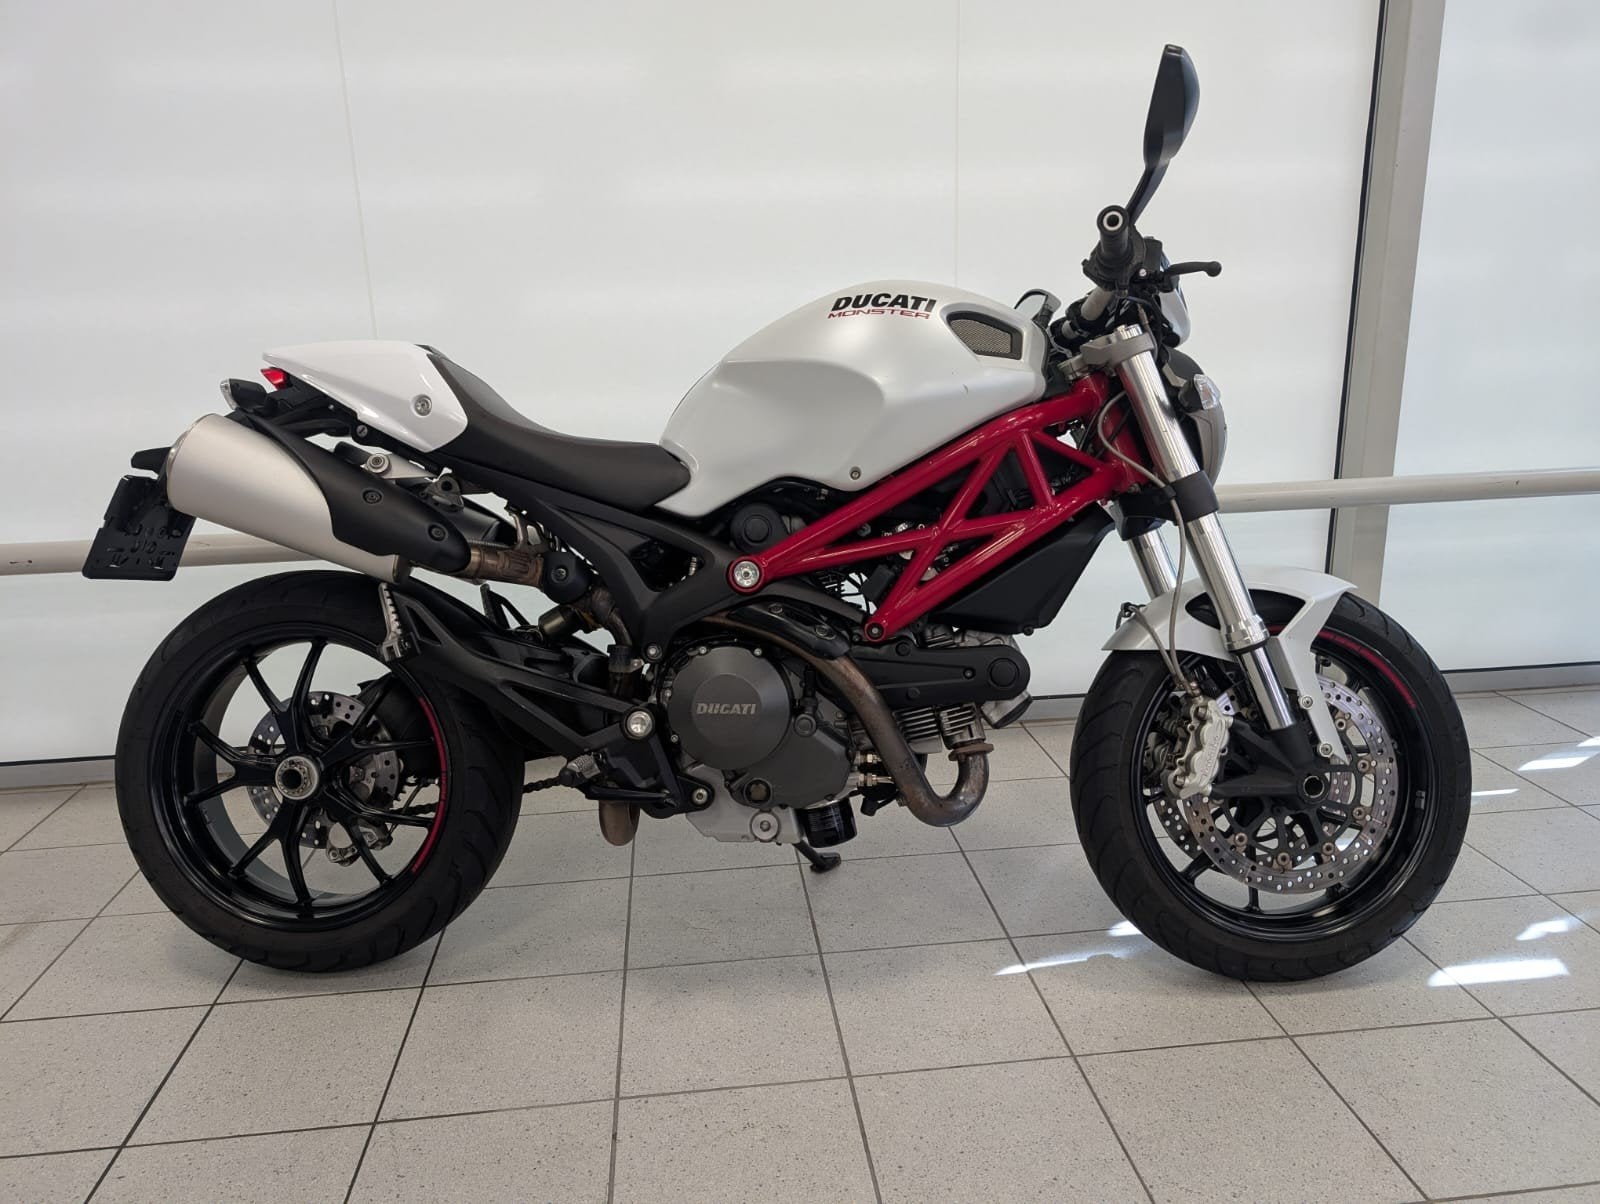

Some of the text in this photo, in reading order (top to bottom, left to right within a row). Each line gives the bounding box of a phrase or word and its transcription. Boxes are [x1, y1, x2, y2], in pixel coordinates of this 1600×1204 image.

[831, 293, 937, 312] DUCATI
[827, 308, 931, 319] MONSTER
[696, 702, 757, 715] DUCATI
